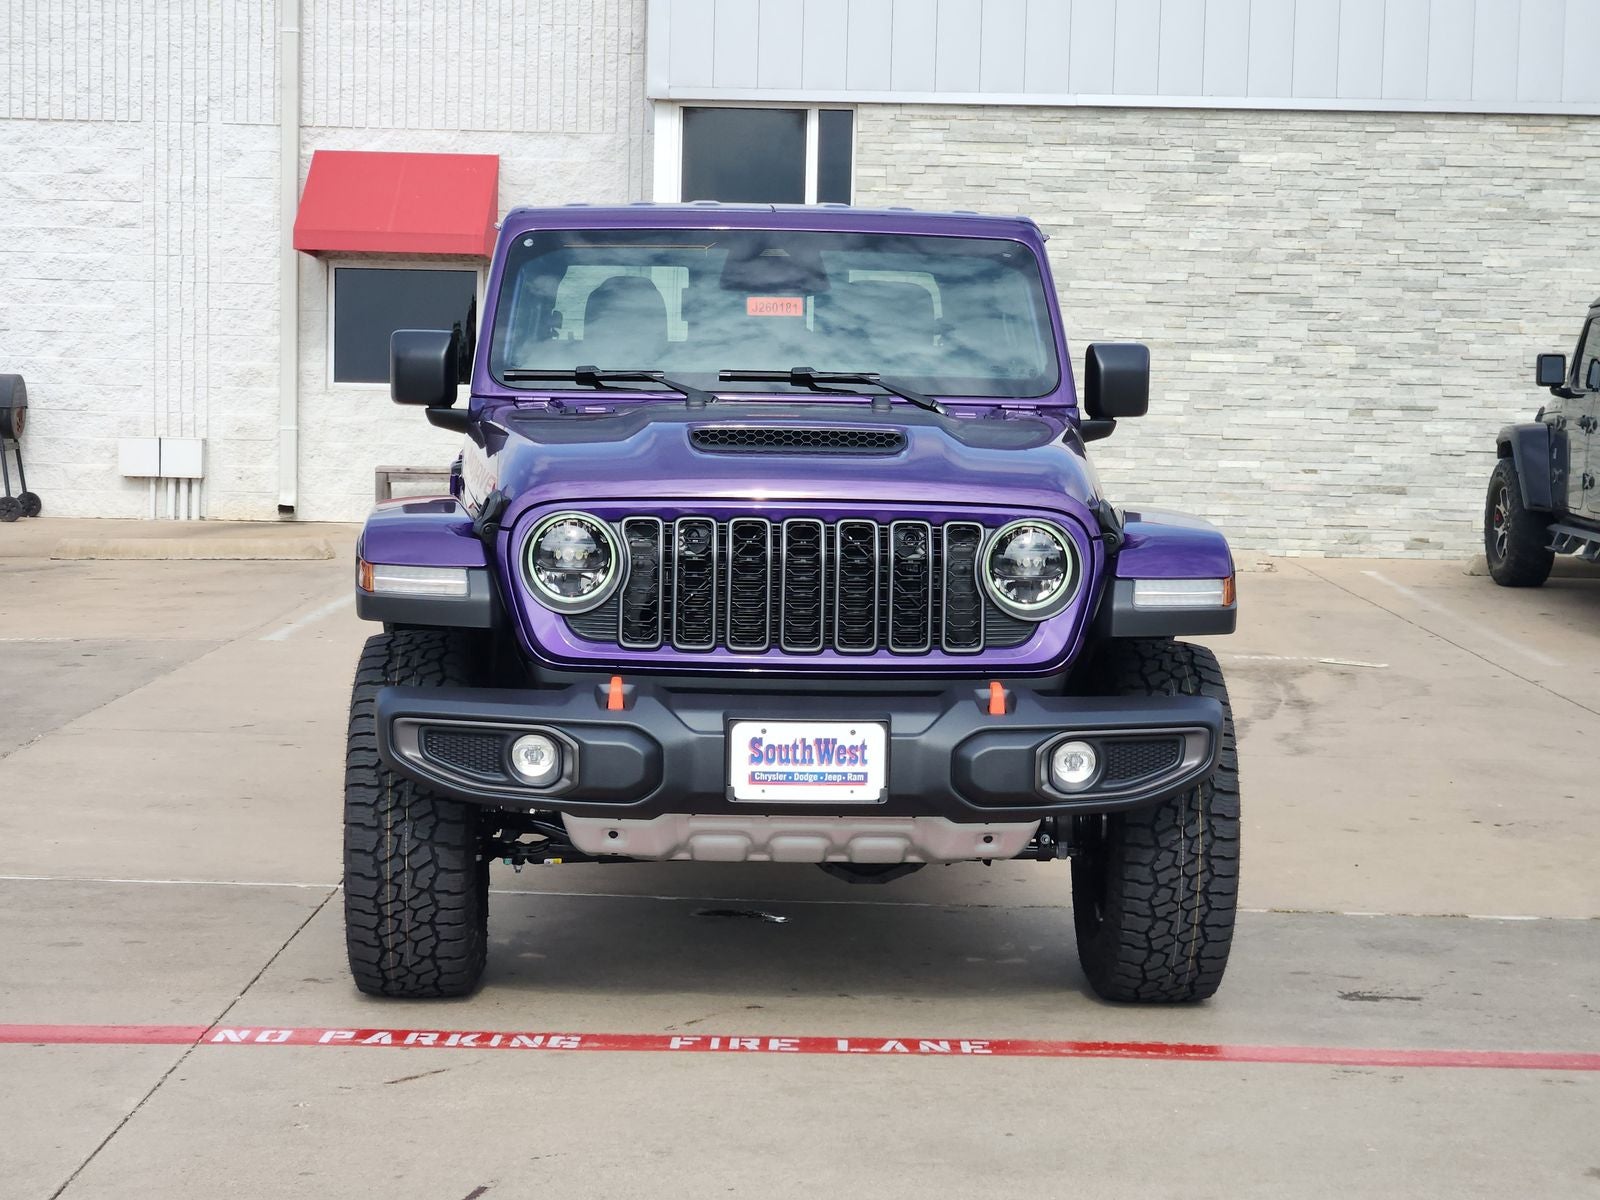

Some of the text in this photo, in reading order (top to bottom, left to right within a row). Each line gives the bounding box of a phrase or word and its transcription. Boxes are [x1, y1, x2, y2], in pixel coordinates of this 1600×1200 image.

[752, 302, 799, 314] J260181
[754, 772, 865, 783] Chrysler Dodge Jeep Ram
[211, 1029, 993, 1054] NO PARKING FIRE LANE
